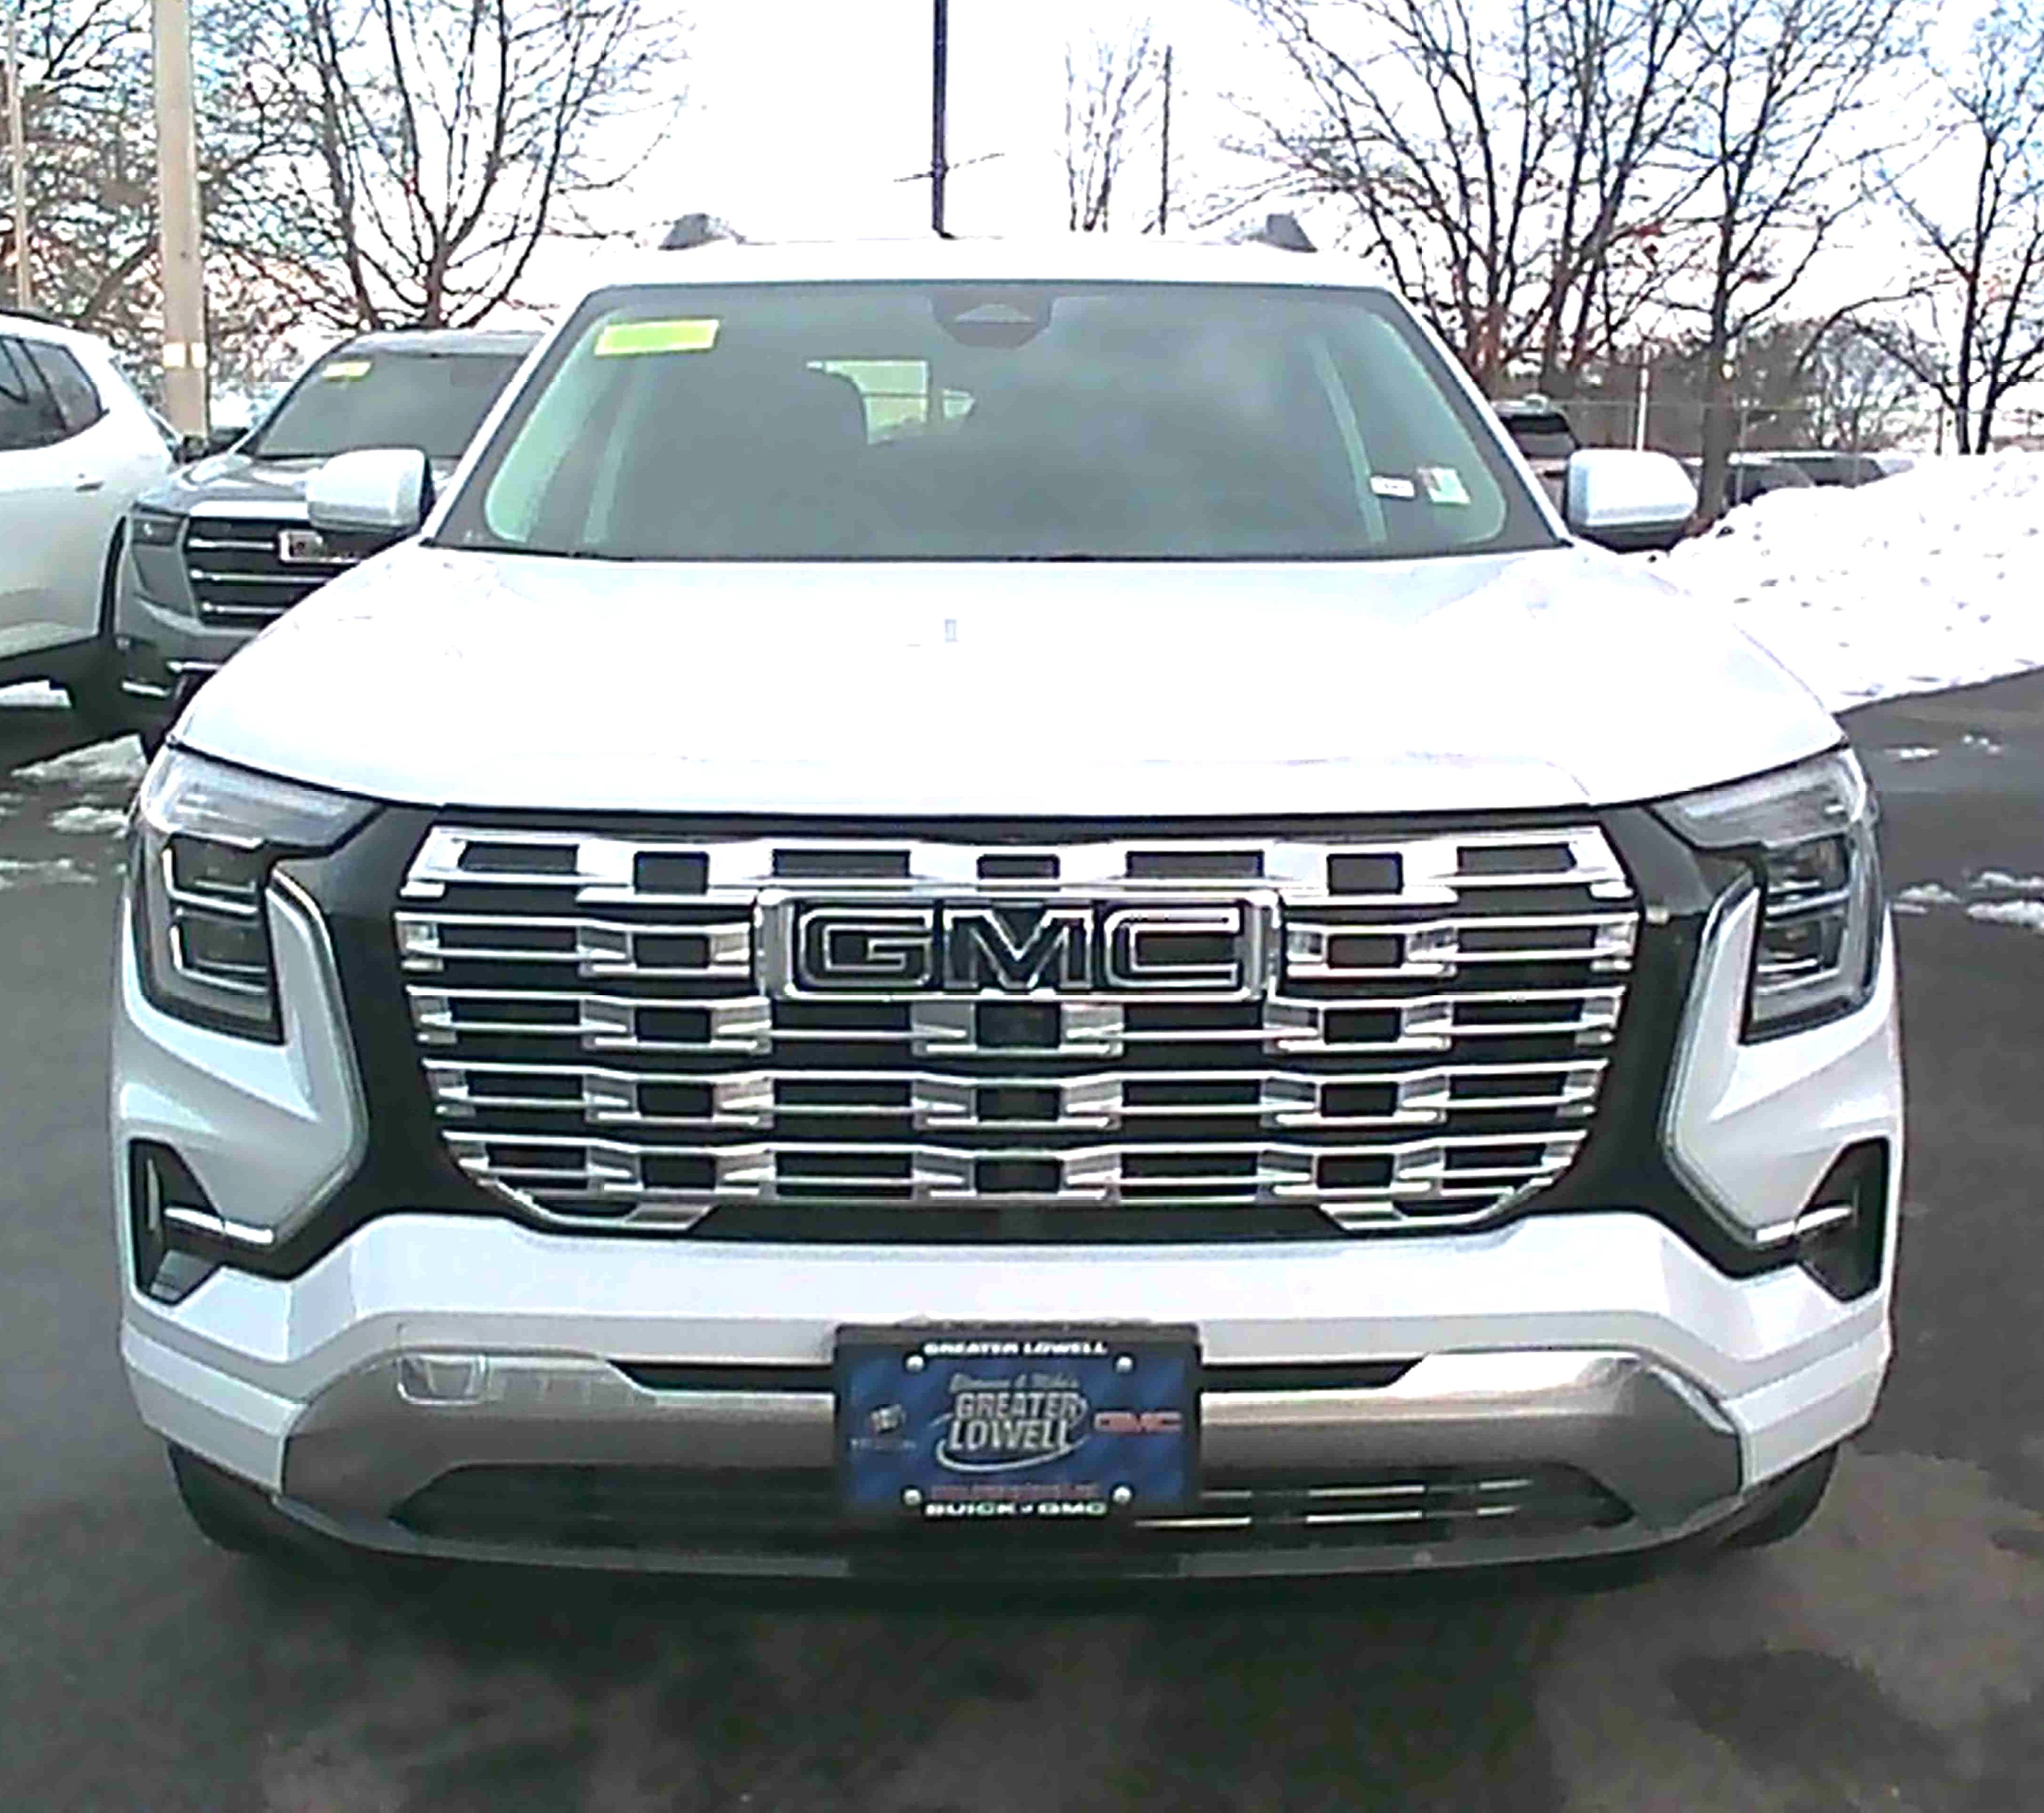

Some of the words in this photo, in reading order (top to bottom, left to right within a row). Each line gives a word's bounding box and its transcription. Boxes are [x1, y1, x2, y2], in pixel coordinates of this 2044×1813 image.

[797, 905, 1241, 990] GMC
[924, 1341, 1018, 1355] GREATER
[1023, 1341, 1108, 1355] LOWELL
[956, 1392, 1080, 1420] GREATER
[949, 1419, 1076, 1450] LOWELL
[1094, 1411, 1181, 1433] GMC
[1038, 1502, 1107, 1516] GMC
